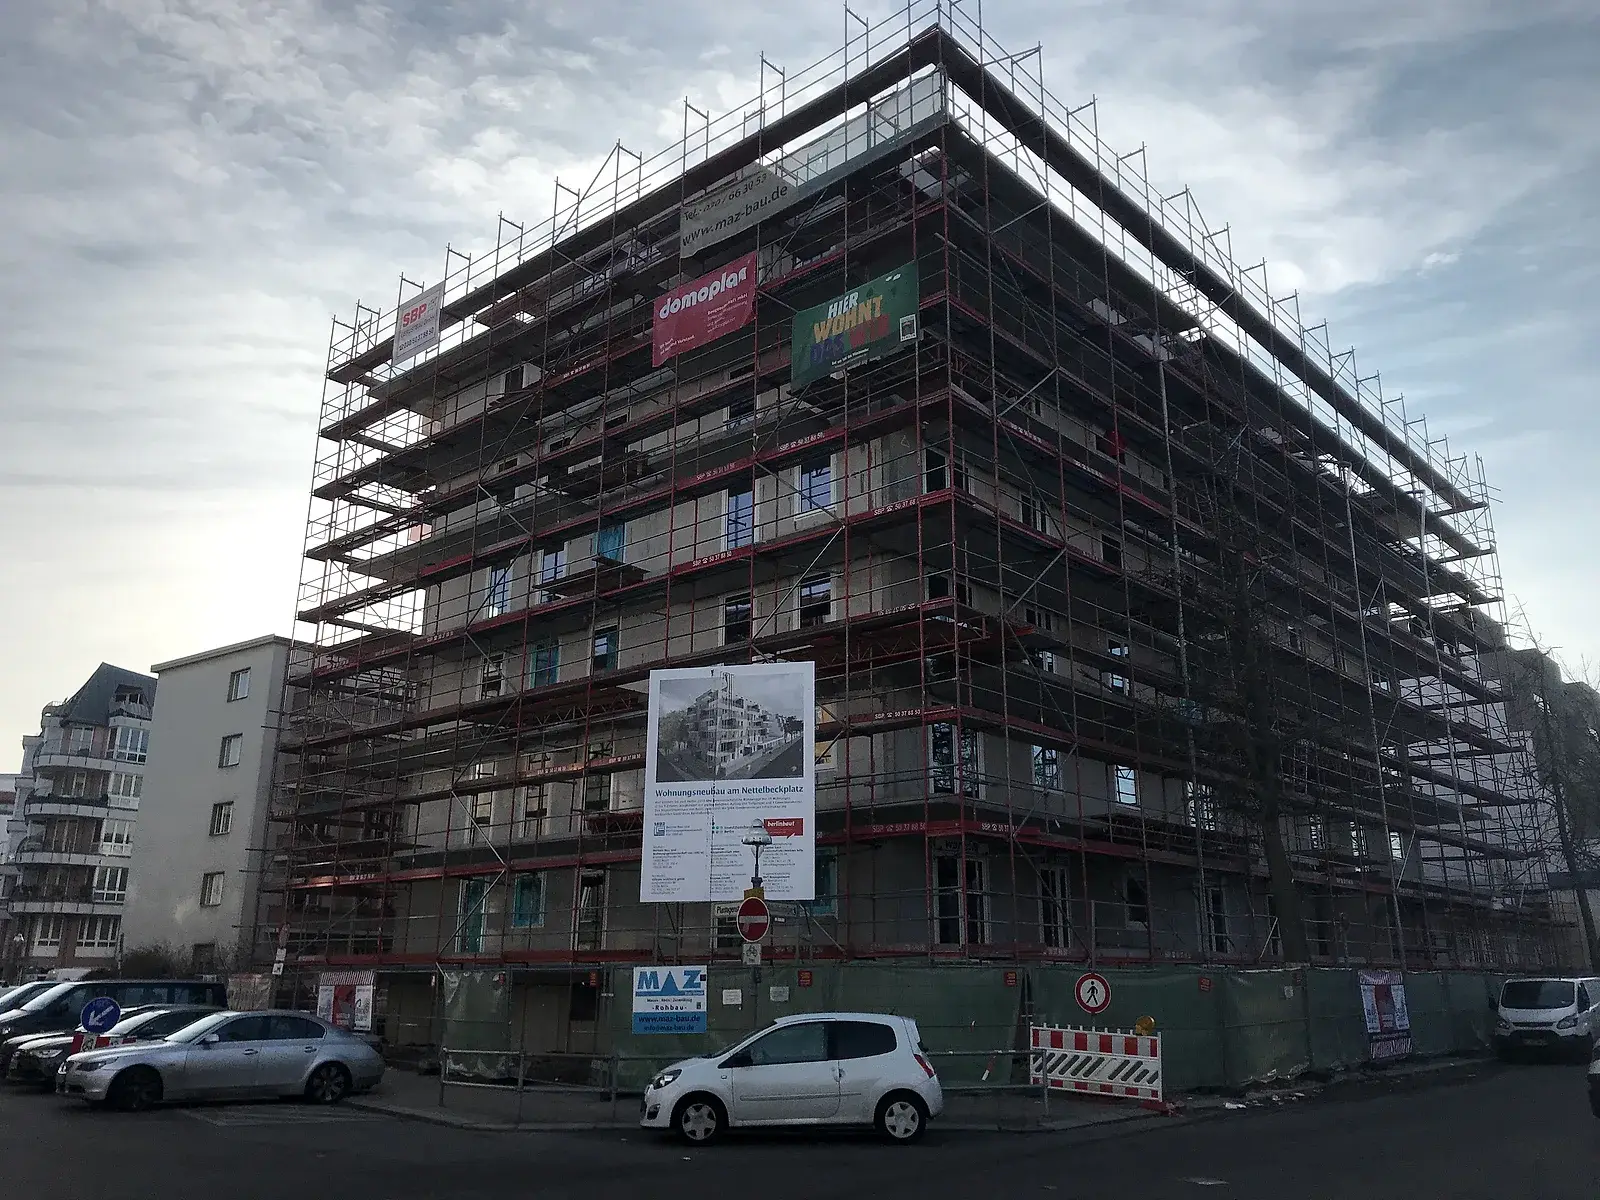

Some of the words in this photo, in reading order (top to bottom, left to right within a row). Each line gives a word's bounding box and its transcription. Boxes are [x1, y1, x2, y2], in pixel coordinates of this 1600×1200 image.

[683, 186, 788, 246] www.maz-bau.de
[402, 303, 427, 328] SBP
[828, 291, 859, 319] HIER
[813, 295, 882, 343] WOHNT
[810, 333, 845, 361] DAS
[655, 787, 725, 798] Wohnungsneubau
[727, 787, 739, 795] am
[741, 785, 804, 795] Nettelbeckplatz
[637, 970, 701, 991] MAZ
[638, 1014, 701, 1023] www.maz-bau.de
